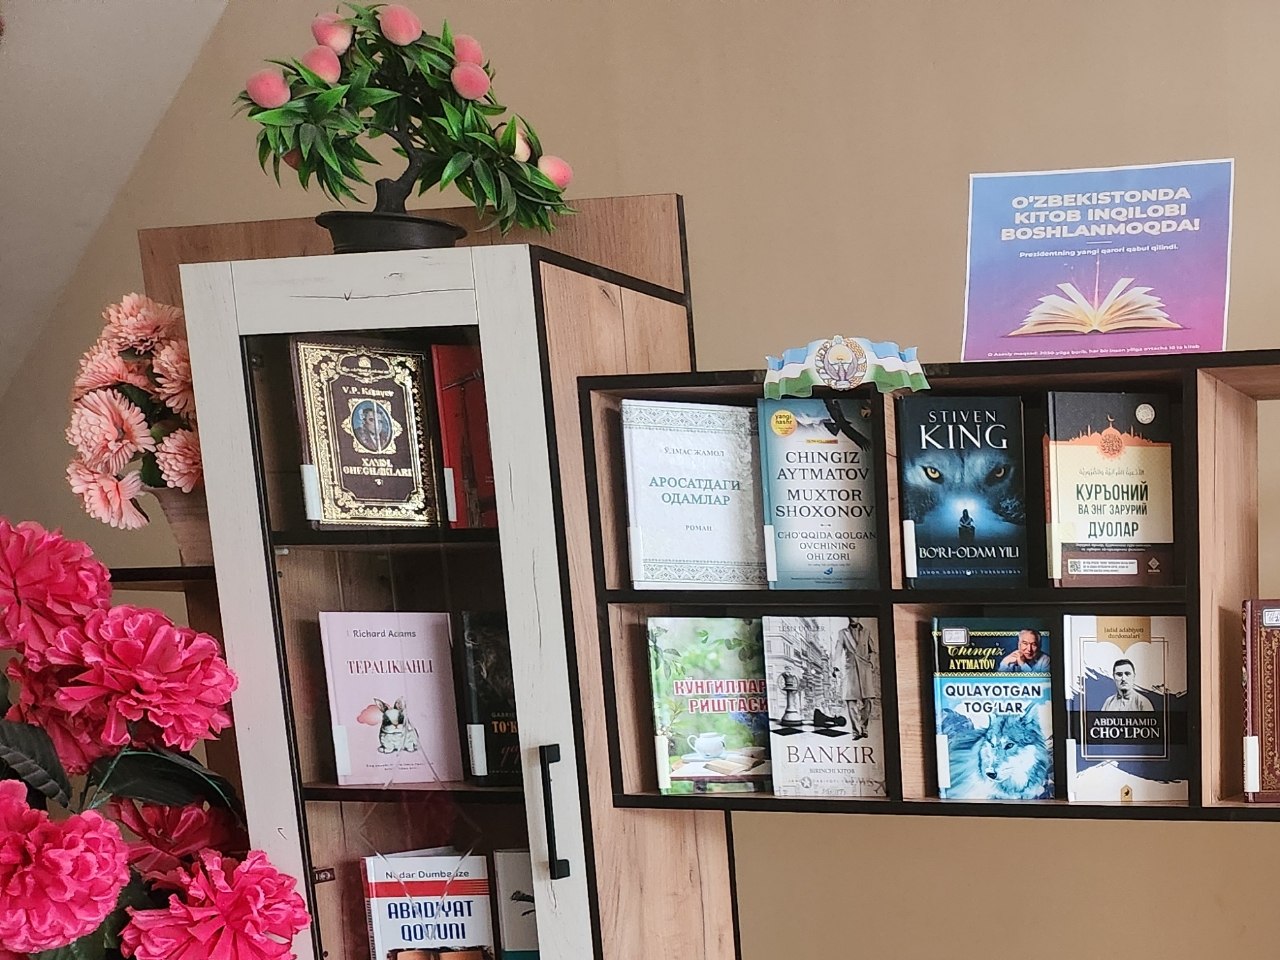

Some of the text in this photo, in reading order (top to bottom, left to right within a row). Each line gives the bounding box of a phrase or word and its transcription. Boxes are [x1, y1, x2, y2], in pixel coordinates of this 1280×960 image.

[1012, 187, 1191, 208] O'ZBEKISTONDA
[1014, 204, 1187, 224] KITOB INQILOBI
[1001, 218, 1200, 240] BOSHLANMOQDA!
[1019, 244, 1178, 258] Prezidentning yangi qarori qabul qilindi.
[928, 410, 996, 423] STIVEN
[920, 424, 1008, 449] KING
[785, 451, 860, 464] CHINGIZ
[777, 468, 869, 480] AYTMATOV
[649, 477, 741, 491] АРОСАТДАГИ
[661, 492, 730, 506] ОДАМЛАР
[787, 489, 862, 501] MUXTOR
[775, 506, 875, 518] SHOXONOV
[1078, 503, 1148, 515] ВА ЭНГ ЗАРУРИЙ
[834, 531, 877, 541] QOLGAN
[1088, 522, 1139, 538] ДУОЛАР
[799, 542, 856, 551] OVCHINING
[919, 546, 1019, 559] BO'RI-ODAM YILI
[825, 552, 850, 561] ZORI
[353, 630, 386, 638] Richard
[947, 642, 1005, 661] Chingiz
[949, 659, 996, 671] AYTMATOV
[945, 684, 1042, 699] QULAYOTGAN
[964, 701, 1024, 714] TOG'LAR
[1094, 718, 1157, 727] ABDULHAMID
[1090, 726, 1160, 739] CHO'LPON
[786, 745, 876, 764] BANKIR
